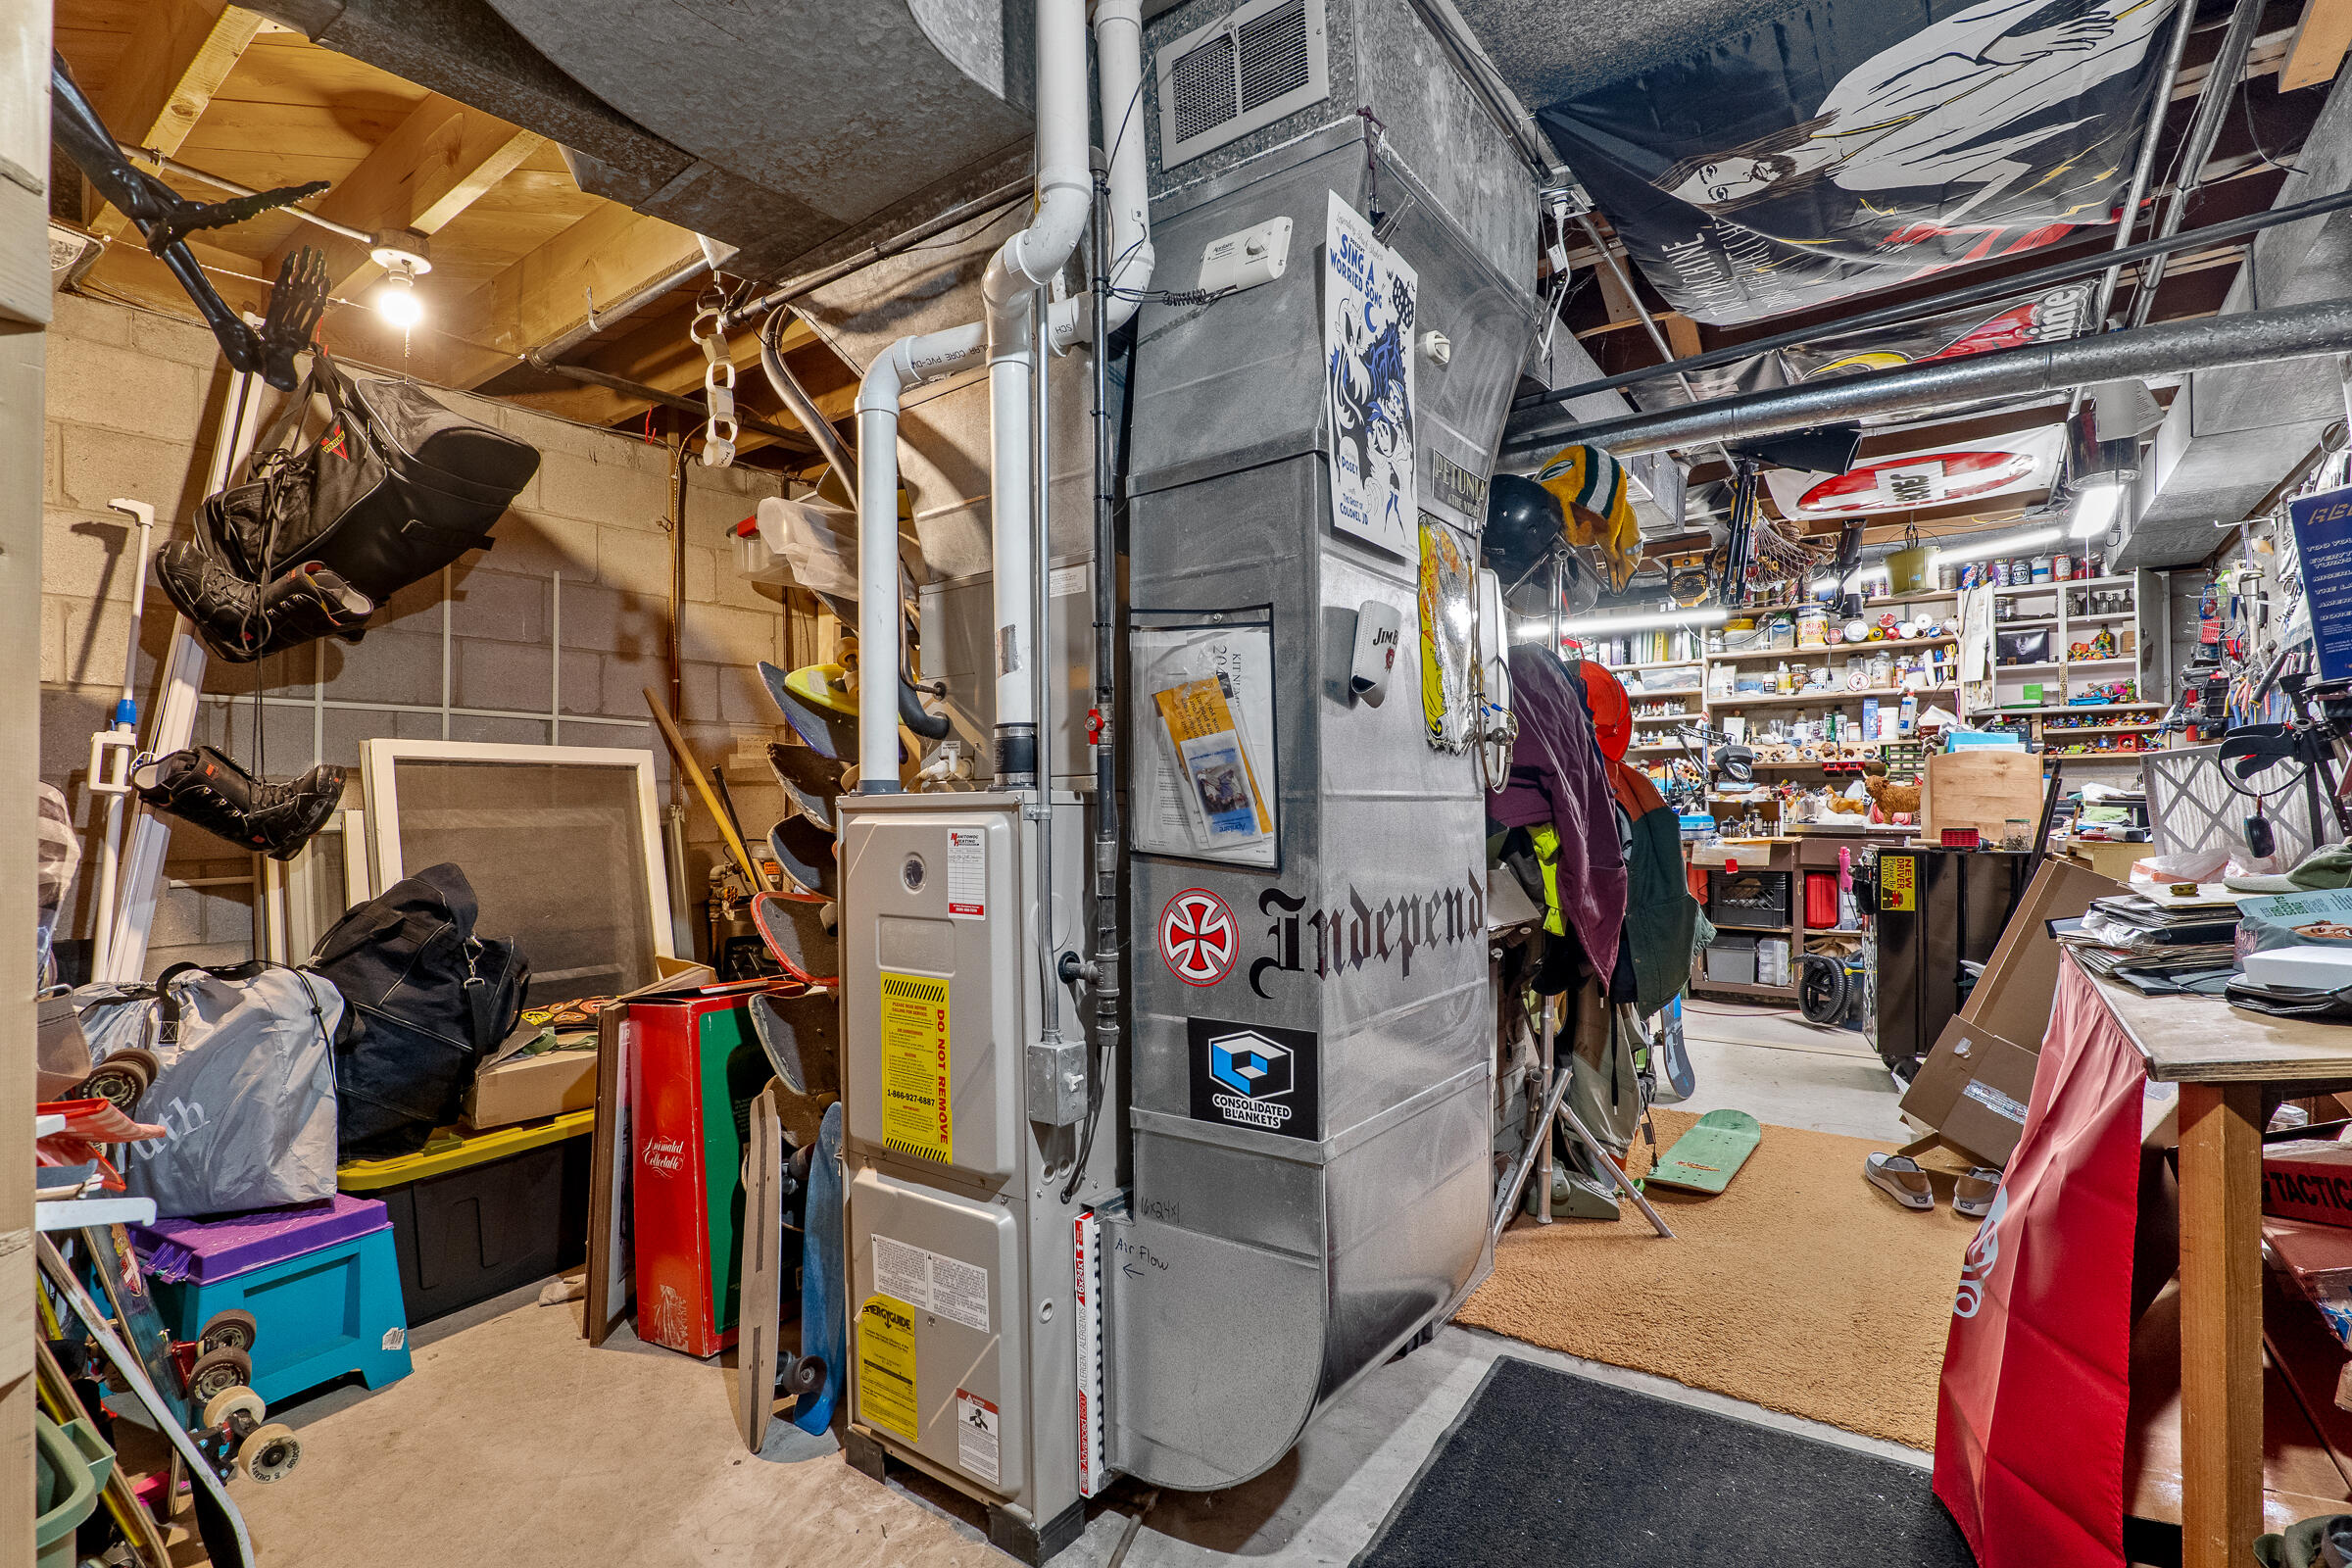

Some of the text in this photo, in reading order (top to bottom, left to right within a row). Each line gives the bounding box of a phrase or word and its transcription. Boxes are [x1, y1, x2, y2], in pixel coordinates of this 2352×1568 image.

[1330, 248, 1363, 292] WORRIED
[1367, 260, 1375, 285] A
[1661, 232, 1734, 299] MACHINE
[1054, 323, 1073, 336] SCH
[2035, 285, 2082, 343] hine
[945, 349, 966, 362] CORE
[1372, 627, 1392, 646] JIM
[1232, 653, 1242, 672] KIT
[1896, 858, 1905, 890] DRIVER
[937, 1008, 949, 1145] DO NOT REMOVE
[1213, 1094, 1291, 1119] CONSOLIDATED
[1224, 1107, 1281, 1129] BLANKETS
[2269, 1171, 2352, 1211] TACTIC
[1115, 1238, 1169, 1271] Air Flow
[1076, 1257, 1085, 1298] 16x24x1
[1079, 1356, 1088, 1391] ALLERGEN
[1079, 1418, 1089, 1464] Advanced
